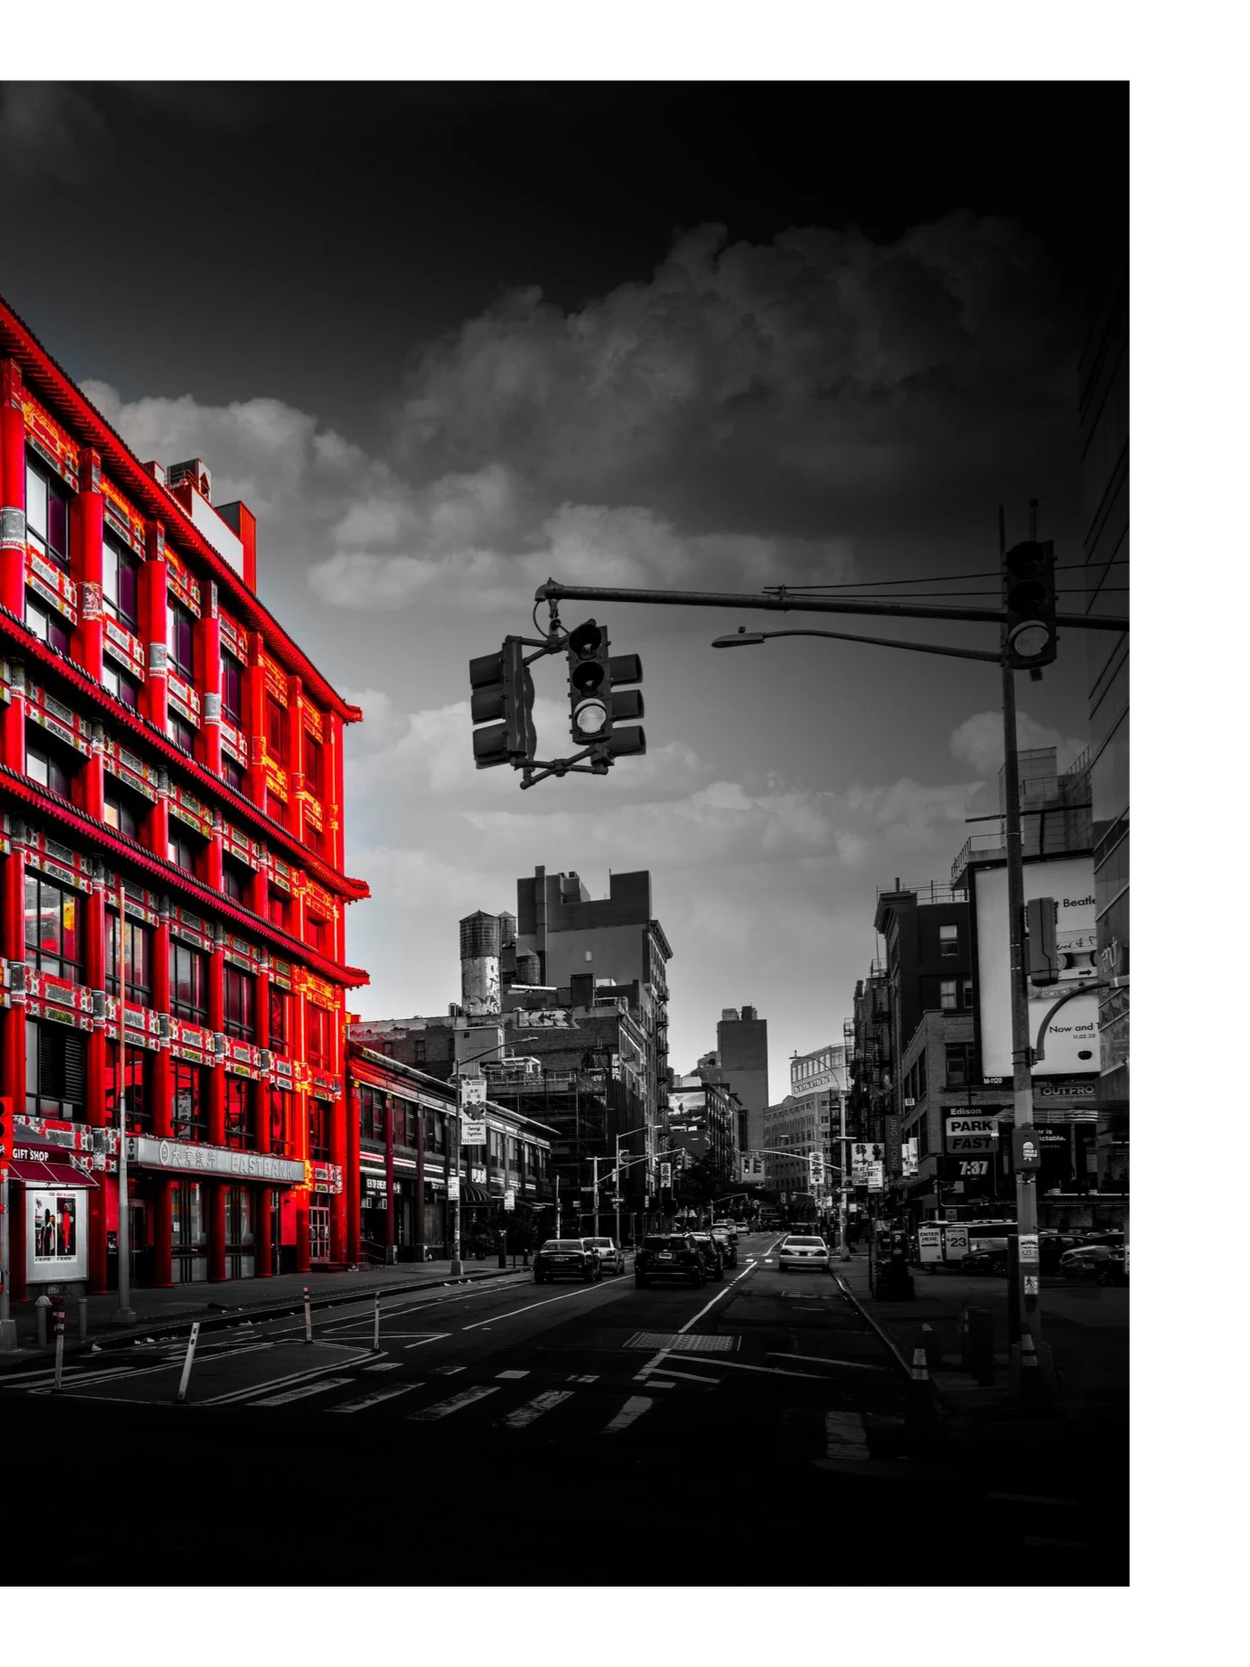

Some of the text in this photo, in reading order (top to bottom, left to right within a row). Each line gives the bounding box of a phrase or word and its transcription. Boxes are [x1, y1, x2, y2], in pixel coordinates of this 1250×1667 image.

[1063, 895, 1096, 908] Beatle
[1050, 1025, 1072, 1033] Now
[1075, 1022, 1093, 1032] and
[983, 1077, 1003, 1085] M-1120
[1042, 1085, 1095, 1096] OUTFRO
[950, 1107, 982, 1115] Edison
[951, 1120, 994, 1132] PARK
[952, 1138, 993, 1149] FAST
[12, 1148, 28, 1160] GIFT
[30, 1149, 49, 1162] SHOP
[890, 1146, 899, 1169] FONG
[231, 1154, 293, 1179] EASTBANK
[959, 1160, 989, 1176] 7:37
